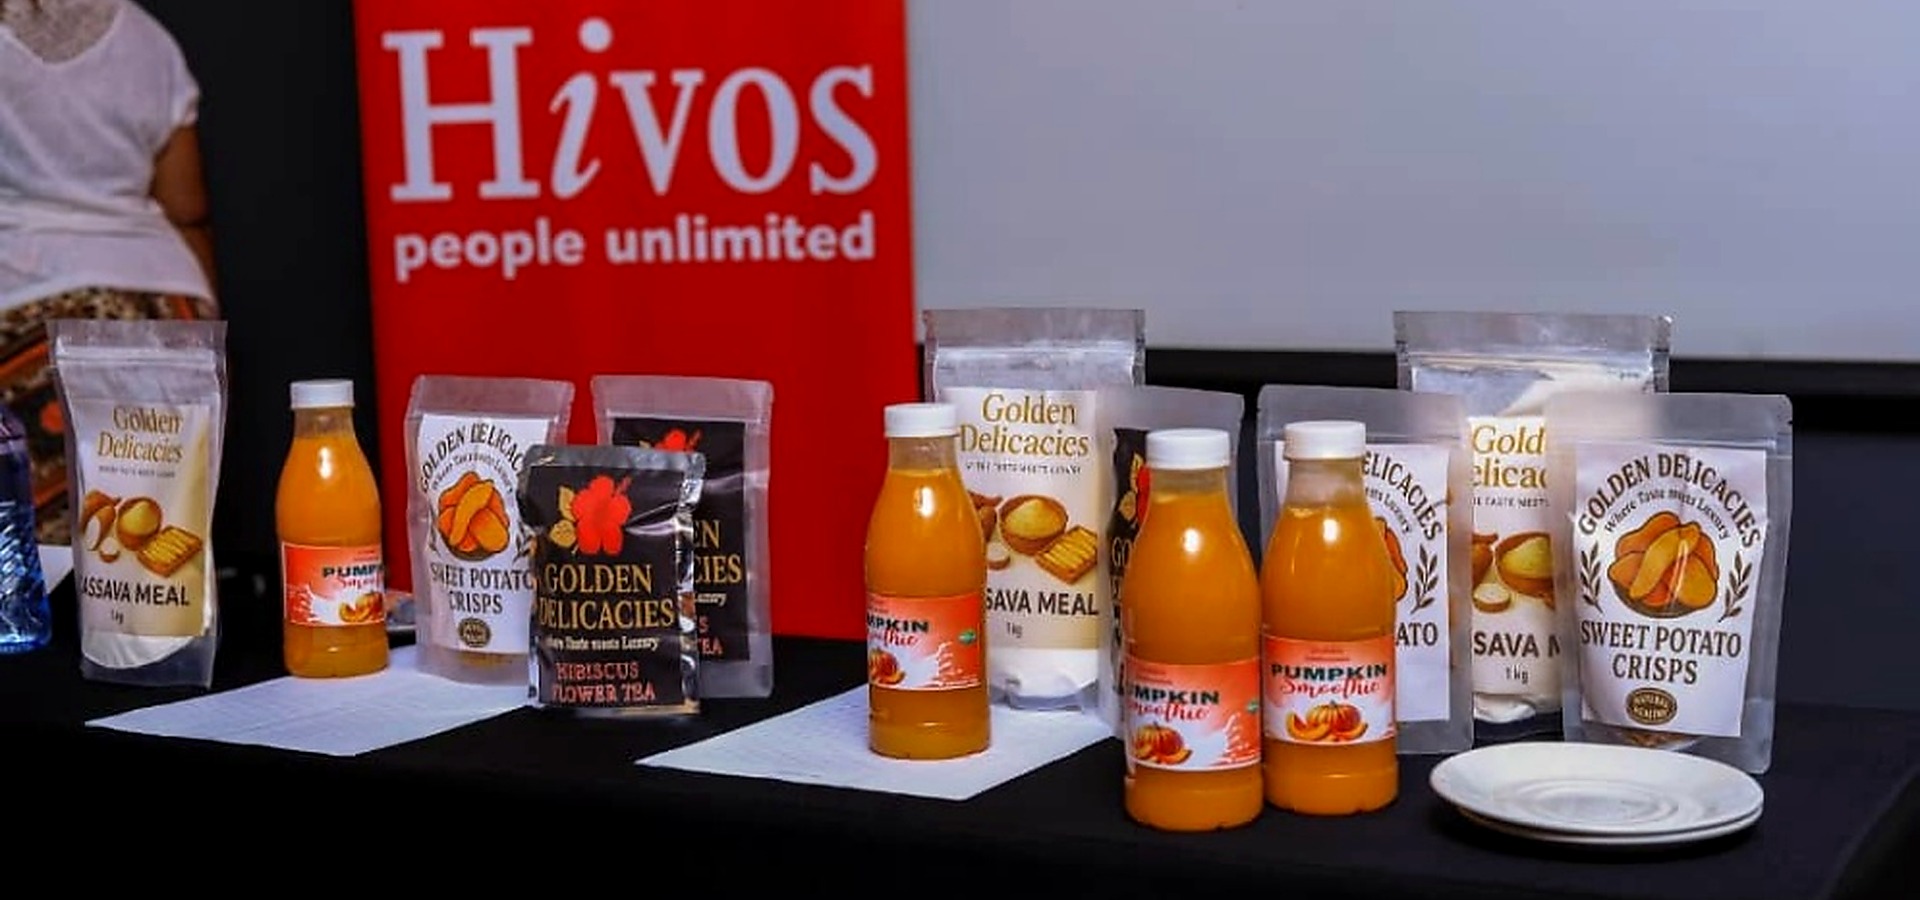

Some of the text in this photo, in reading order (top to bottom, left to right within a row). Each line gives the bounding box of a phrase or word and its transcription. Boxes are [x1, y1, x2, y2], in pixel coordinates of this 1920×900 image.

[382, 17, 878, 202] Hivos
[395, 211, 875, 283] people unlimited
[113, 405, 183, 435] Golden
[982, 394, 1076, 425] Golden
[98, 431, 183, 463] Delicacies
[960, 424, 1090, 457] Delicacies
[419, 428, 465, 493] GOLDEN
[1578, 453, 1762, 548] GOLDEN DELICACIES
[431, 563, 534, 591] SWEET POTATO
[544, 564, 654, 594] GOLDEN
[135, 583, 190, 606] MEAL
[450, 590, 503, 614] CRISPS
[1038, 591, 1099, 616] MEAL
[538, 597, 677, 630] DELICACIES
[1580, 620, 1650, 649] SWEET
[1655, 626, 1742, 658] POTATO
[555, 662, 640, 681] HIBISCUS
[1271, 664, 1387, 681] PUMPKIN
[1612, 653, 1698, 684] CRISPS
[553, 683, 656, 703] FLOWER TEA
[1280, 679, 1380, 699] Smoothie
